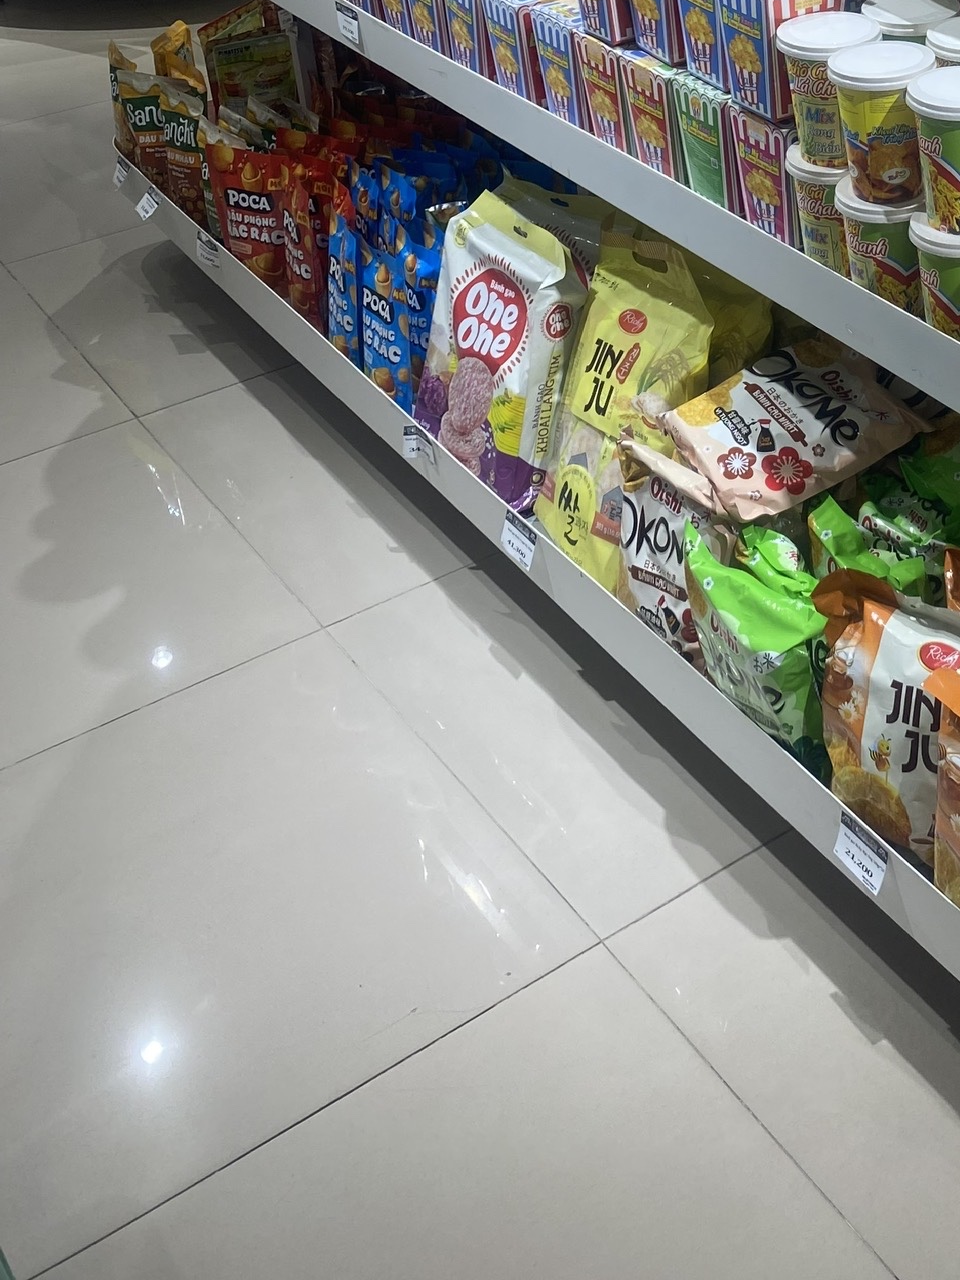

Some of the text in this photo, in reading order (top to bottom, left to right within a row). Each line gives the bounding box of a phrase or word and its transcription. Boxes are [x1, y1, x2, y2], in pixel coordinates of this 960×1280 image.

[227, 189, 271, 212] POCA
[363, 287, 391, 323] POCA
[465, 281, 519, 331] One
[457, 316, 511, 359] One
[585, 337, 625, 380] JIN
[584, 379, 615, 417] JU
[820, 370, 858, 403] Oishi
[651, 475, 686, 515] Oishi
[929, 646, 960, 671] Richy
[844, 847, 874, 879] 21,200
